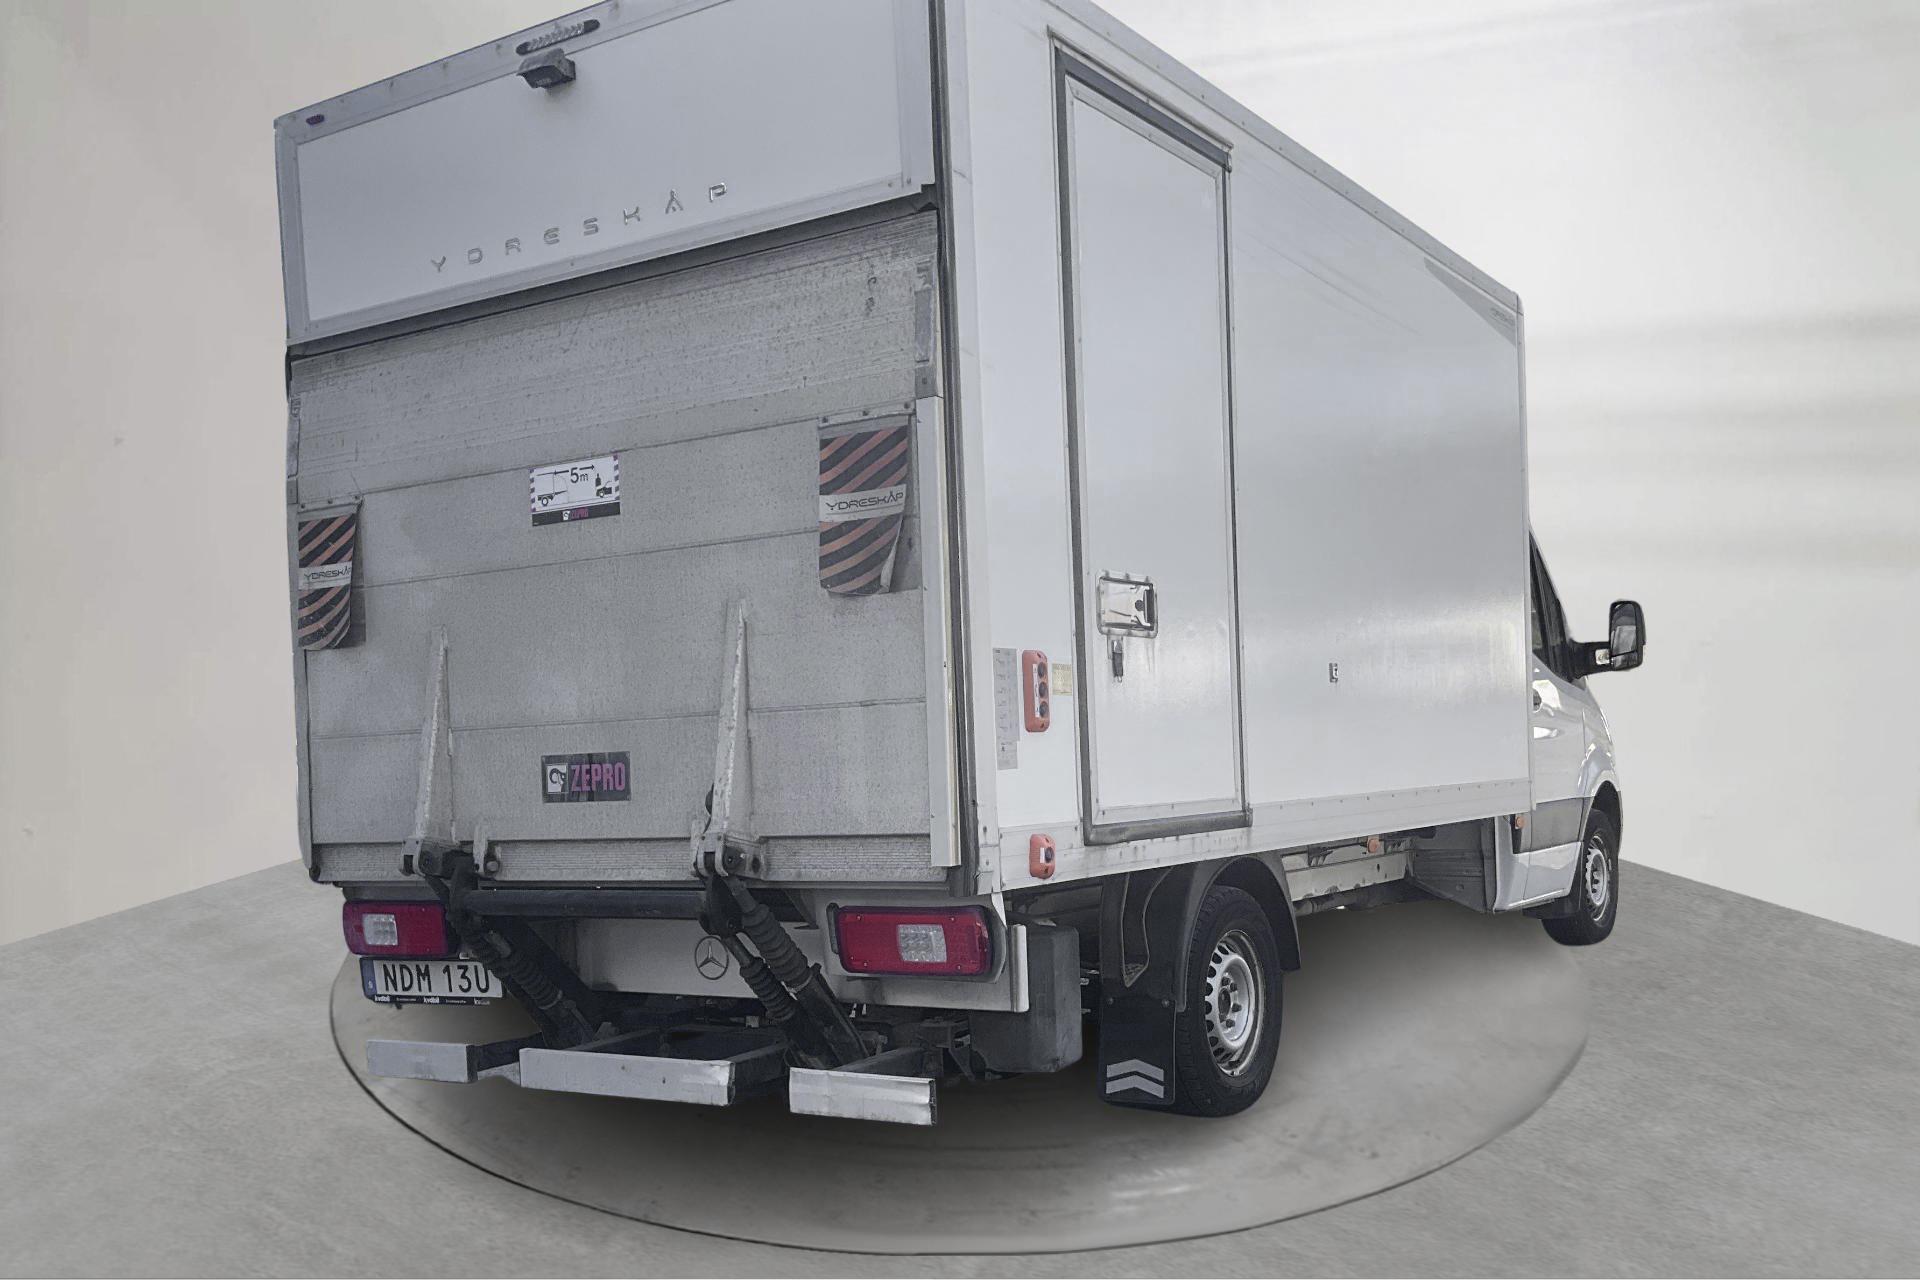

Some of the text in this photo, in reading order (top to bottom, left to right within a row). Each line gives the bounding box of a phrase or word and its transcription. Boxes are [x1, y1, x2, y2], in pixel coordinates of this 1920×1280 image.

[431, 182, 727, 272] YDRESKÅP
[825, 491, 904, 511] YDRESKÅP
[570, 762, 626, 792] ZEPRO
[382, 963, 433, 992] NDM
